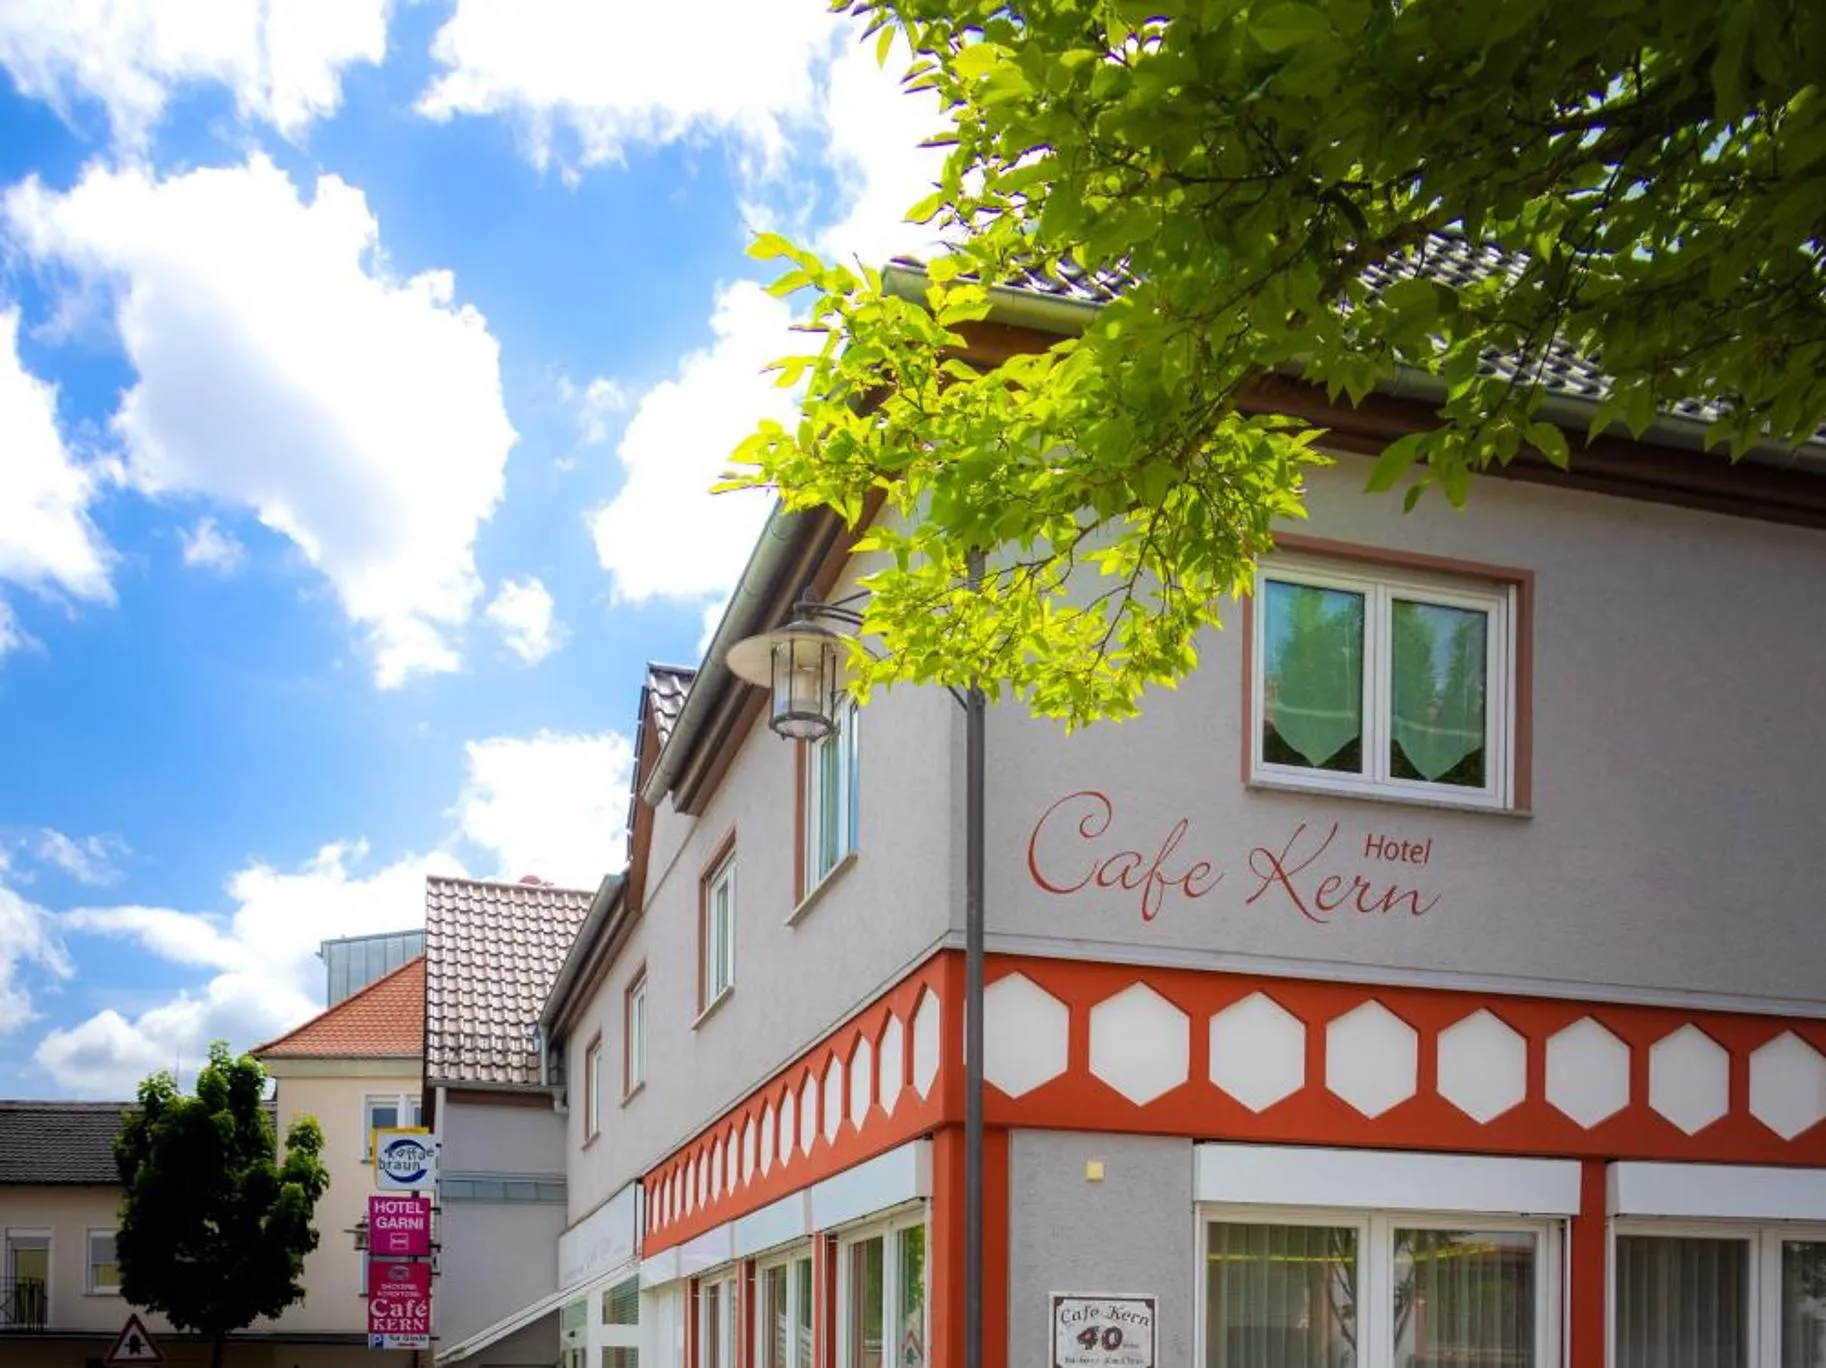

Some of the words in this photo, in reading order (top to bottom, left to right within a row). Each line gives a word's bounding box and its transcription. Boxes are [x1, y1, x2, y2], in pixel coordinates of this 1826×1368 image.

[1027, 790, 1225, 922] Cafe
[1246, 820, 1443, 924] Kern
[1364, 832, 1433, 865] Hotel
[378, 1158, 421, 1172] braun
[375, 1200, 425, 1214] HOTEL
[376, 1216, 424, 1230] GARNI
[370, 1298, 427, 1318] Café
[1107, 1305, 1150, 1327] Kern
[373, 1318, 425, 1331] KERN
[1076, 1326, 1123, 1351] 40
